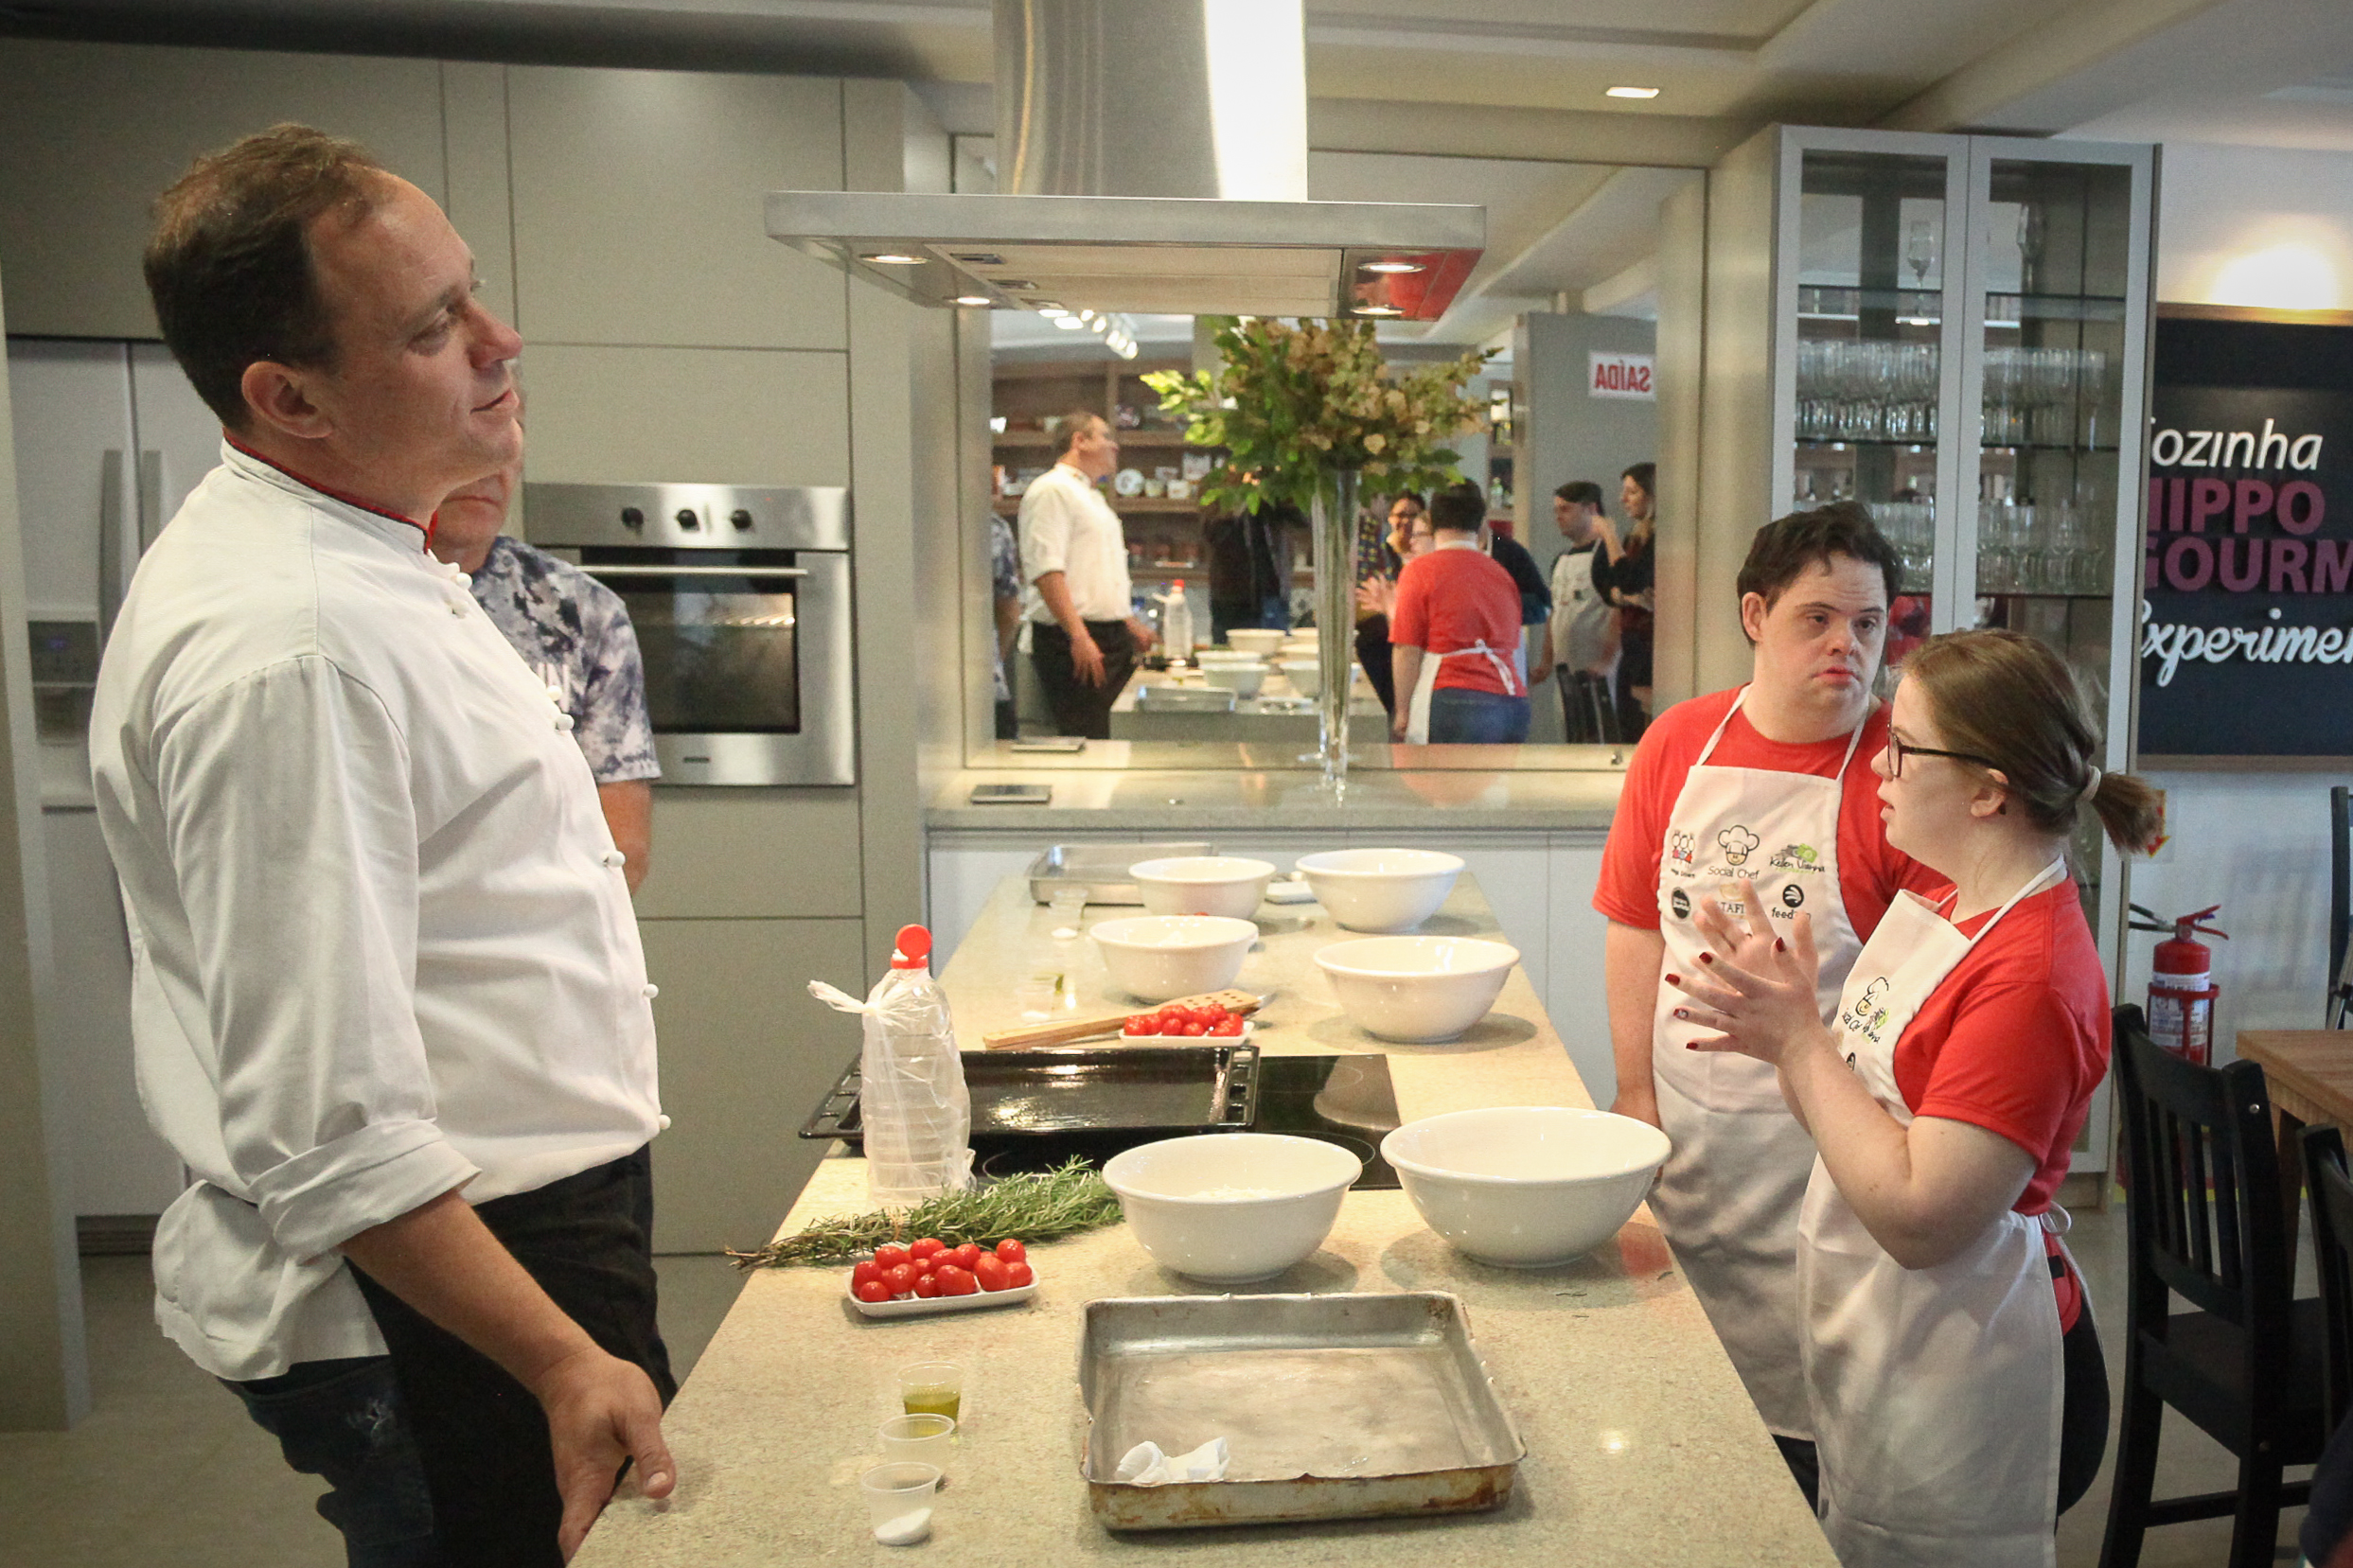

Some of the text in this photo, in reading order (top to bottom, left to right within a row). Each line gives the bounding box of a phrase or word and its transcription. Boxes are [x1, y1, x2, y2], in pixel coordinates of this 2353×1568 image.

[2150, 417, 2324, 470] ozinha
[2141, 598, 2353, 687] xperime
[1707, 865, 1734, 877] Social
[1737, 868, 1760, 880] Chef
